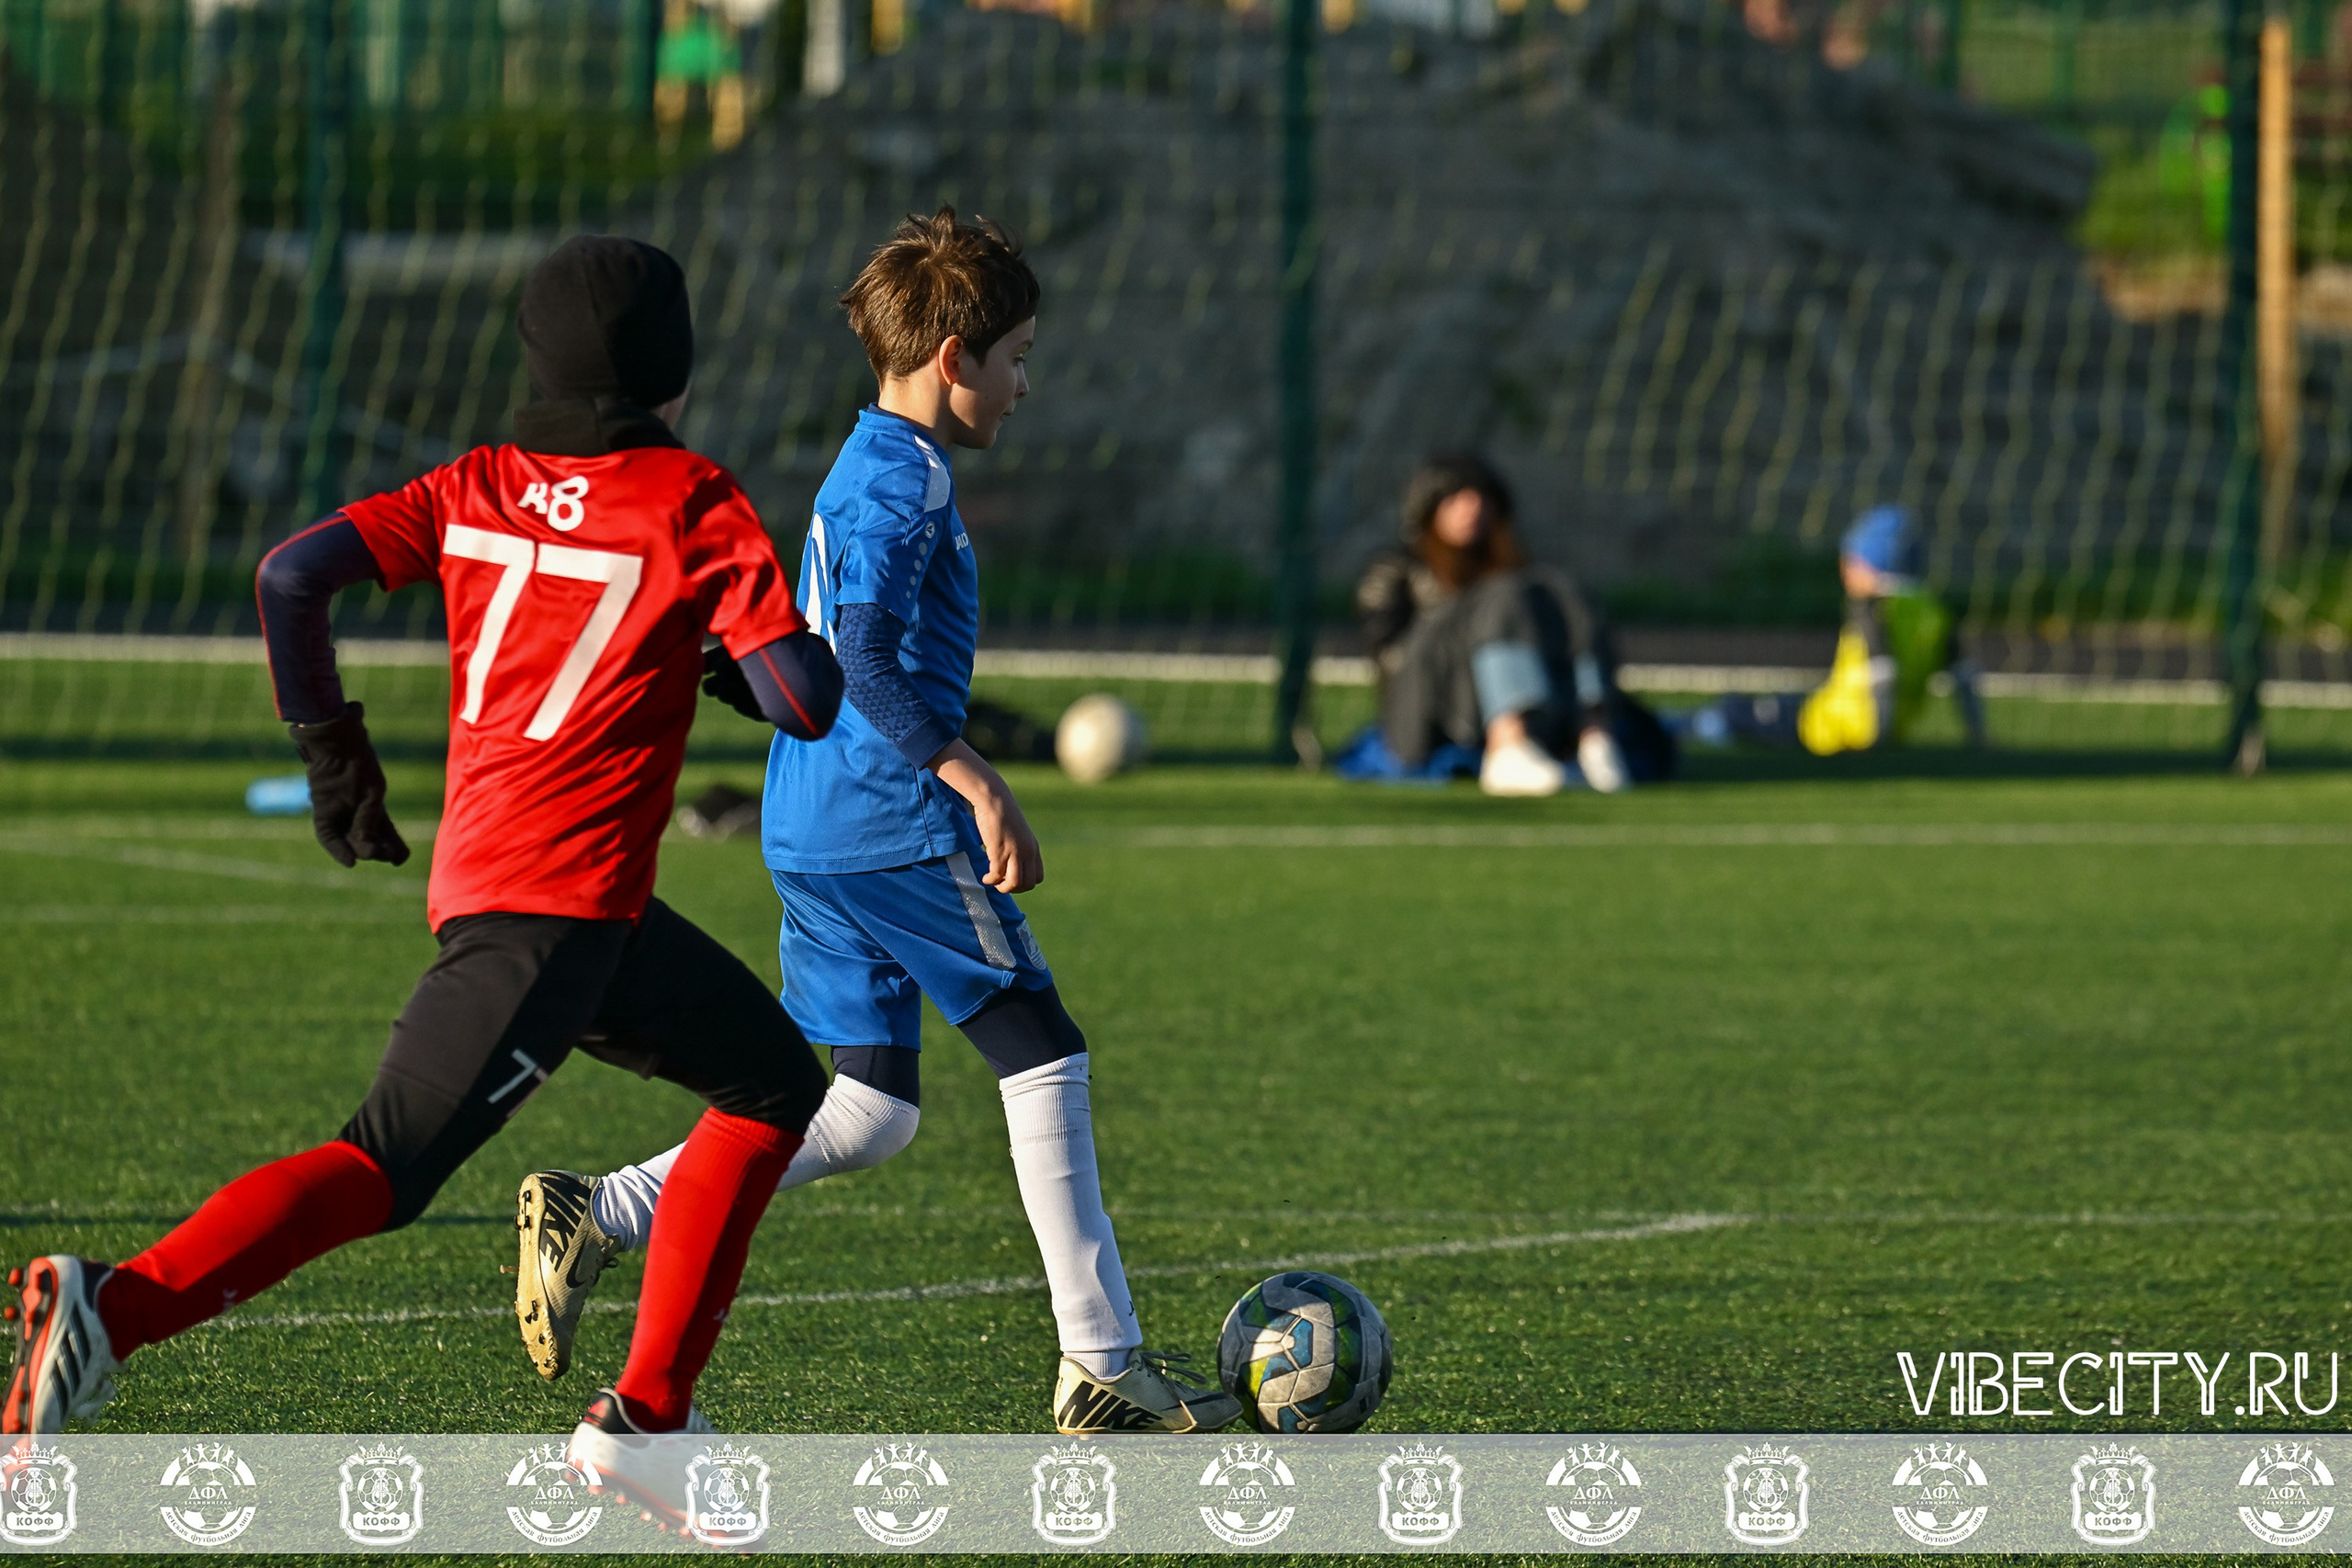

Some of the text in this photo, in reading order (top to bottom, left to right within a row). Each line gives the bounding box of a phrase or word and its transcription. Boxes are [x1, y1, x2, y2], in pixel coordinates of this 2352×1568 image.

[443, 524, 642, 741] 77
[537, 1171, 593, 1273] NIKE
[1057, 1380, 1163, 1430] NIKE
